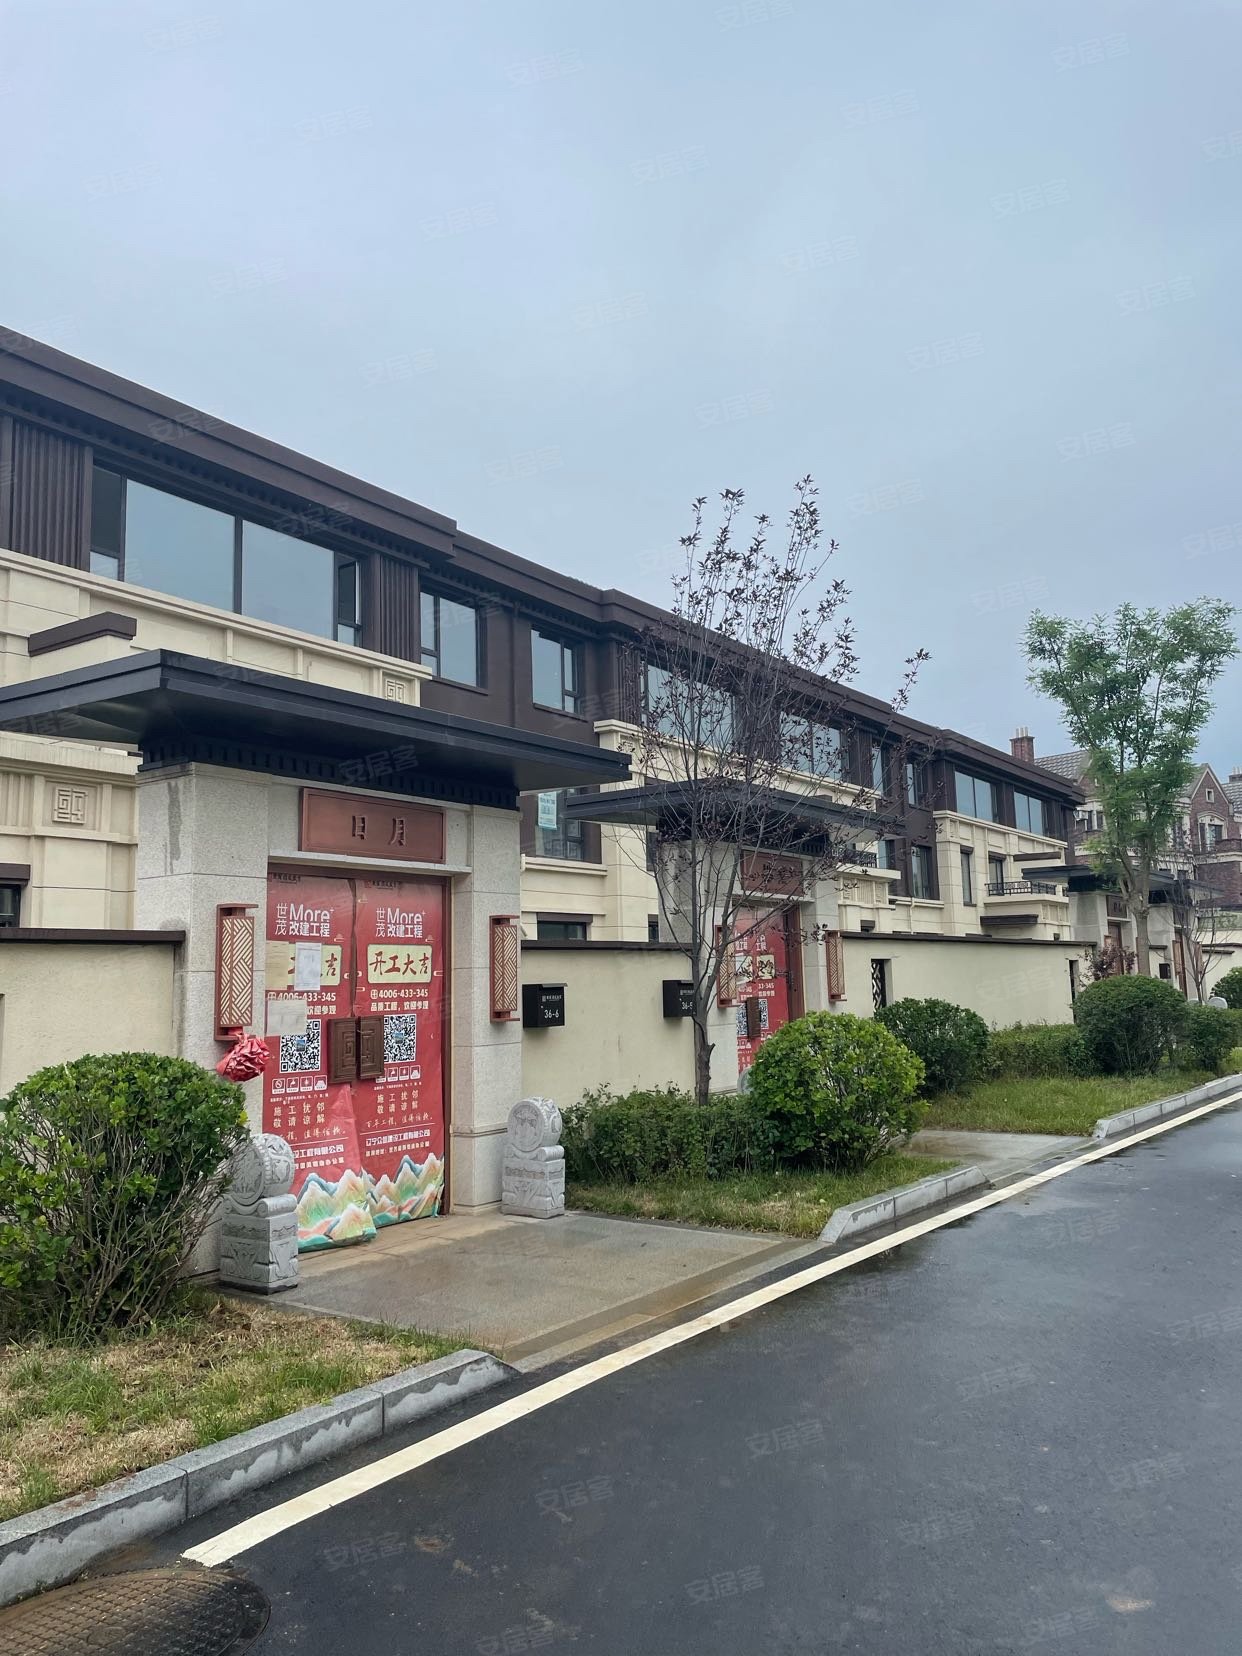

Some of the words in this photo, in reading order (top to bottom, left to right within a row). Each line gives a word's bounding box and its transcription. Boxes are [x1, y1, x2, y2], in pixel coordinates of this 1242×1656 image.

[289, 921, 330, 937] 改建工程
[387, 924, 423, 938] 改建工程
[369, 951, 430, 976] 开工大吉
[277, 992, 336, 1002] 4006-433-345
[379, 989, 429, 999] 4006-433-345
[544, 1009, 559, 1018] 36-6
